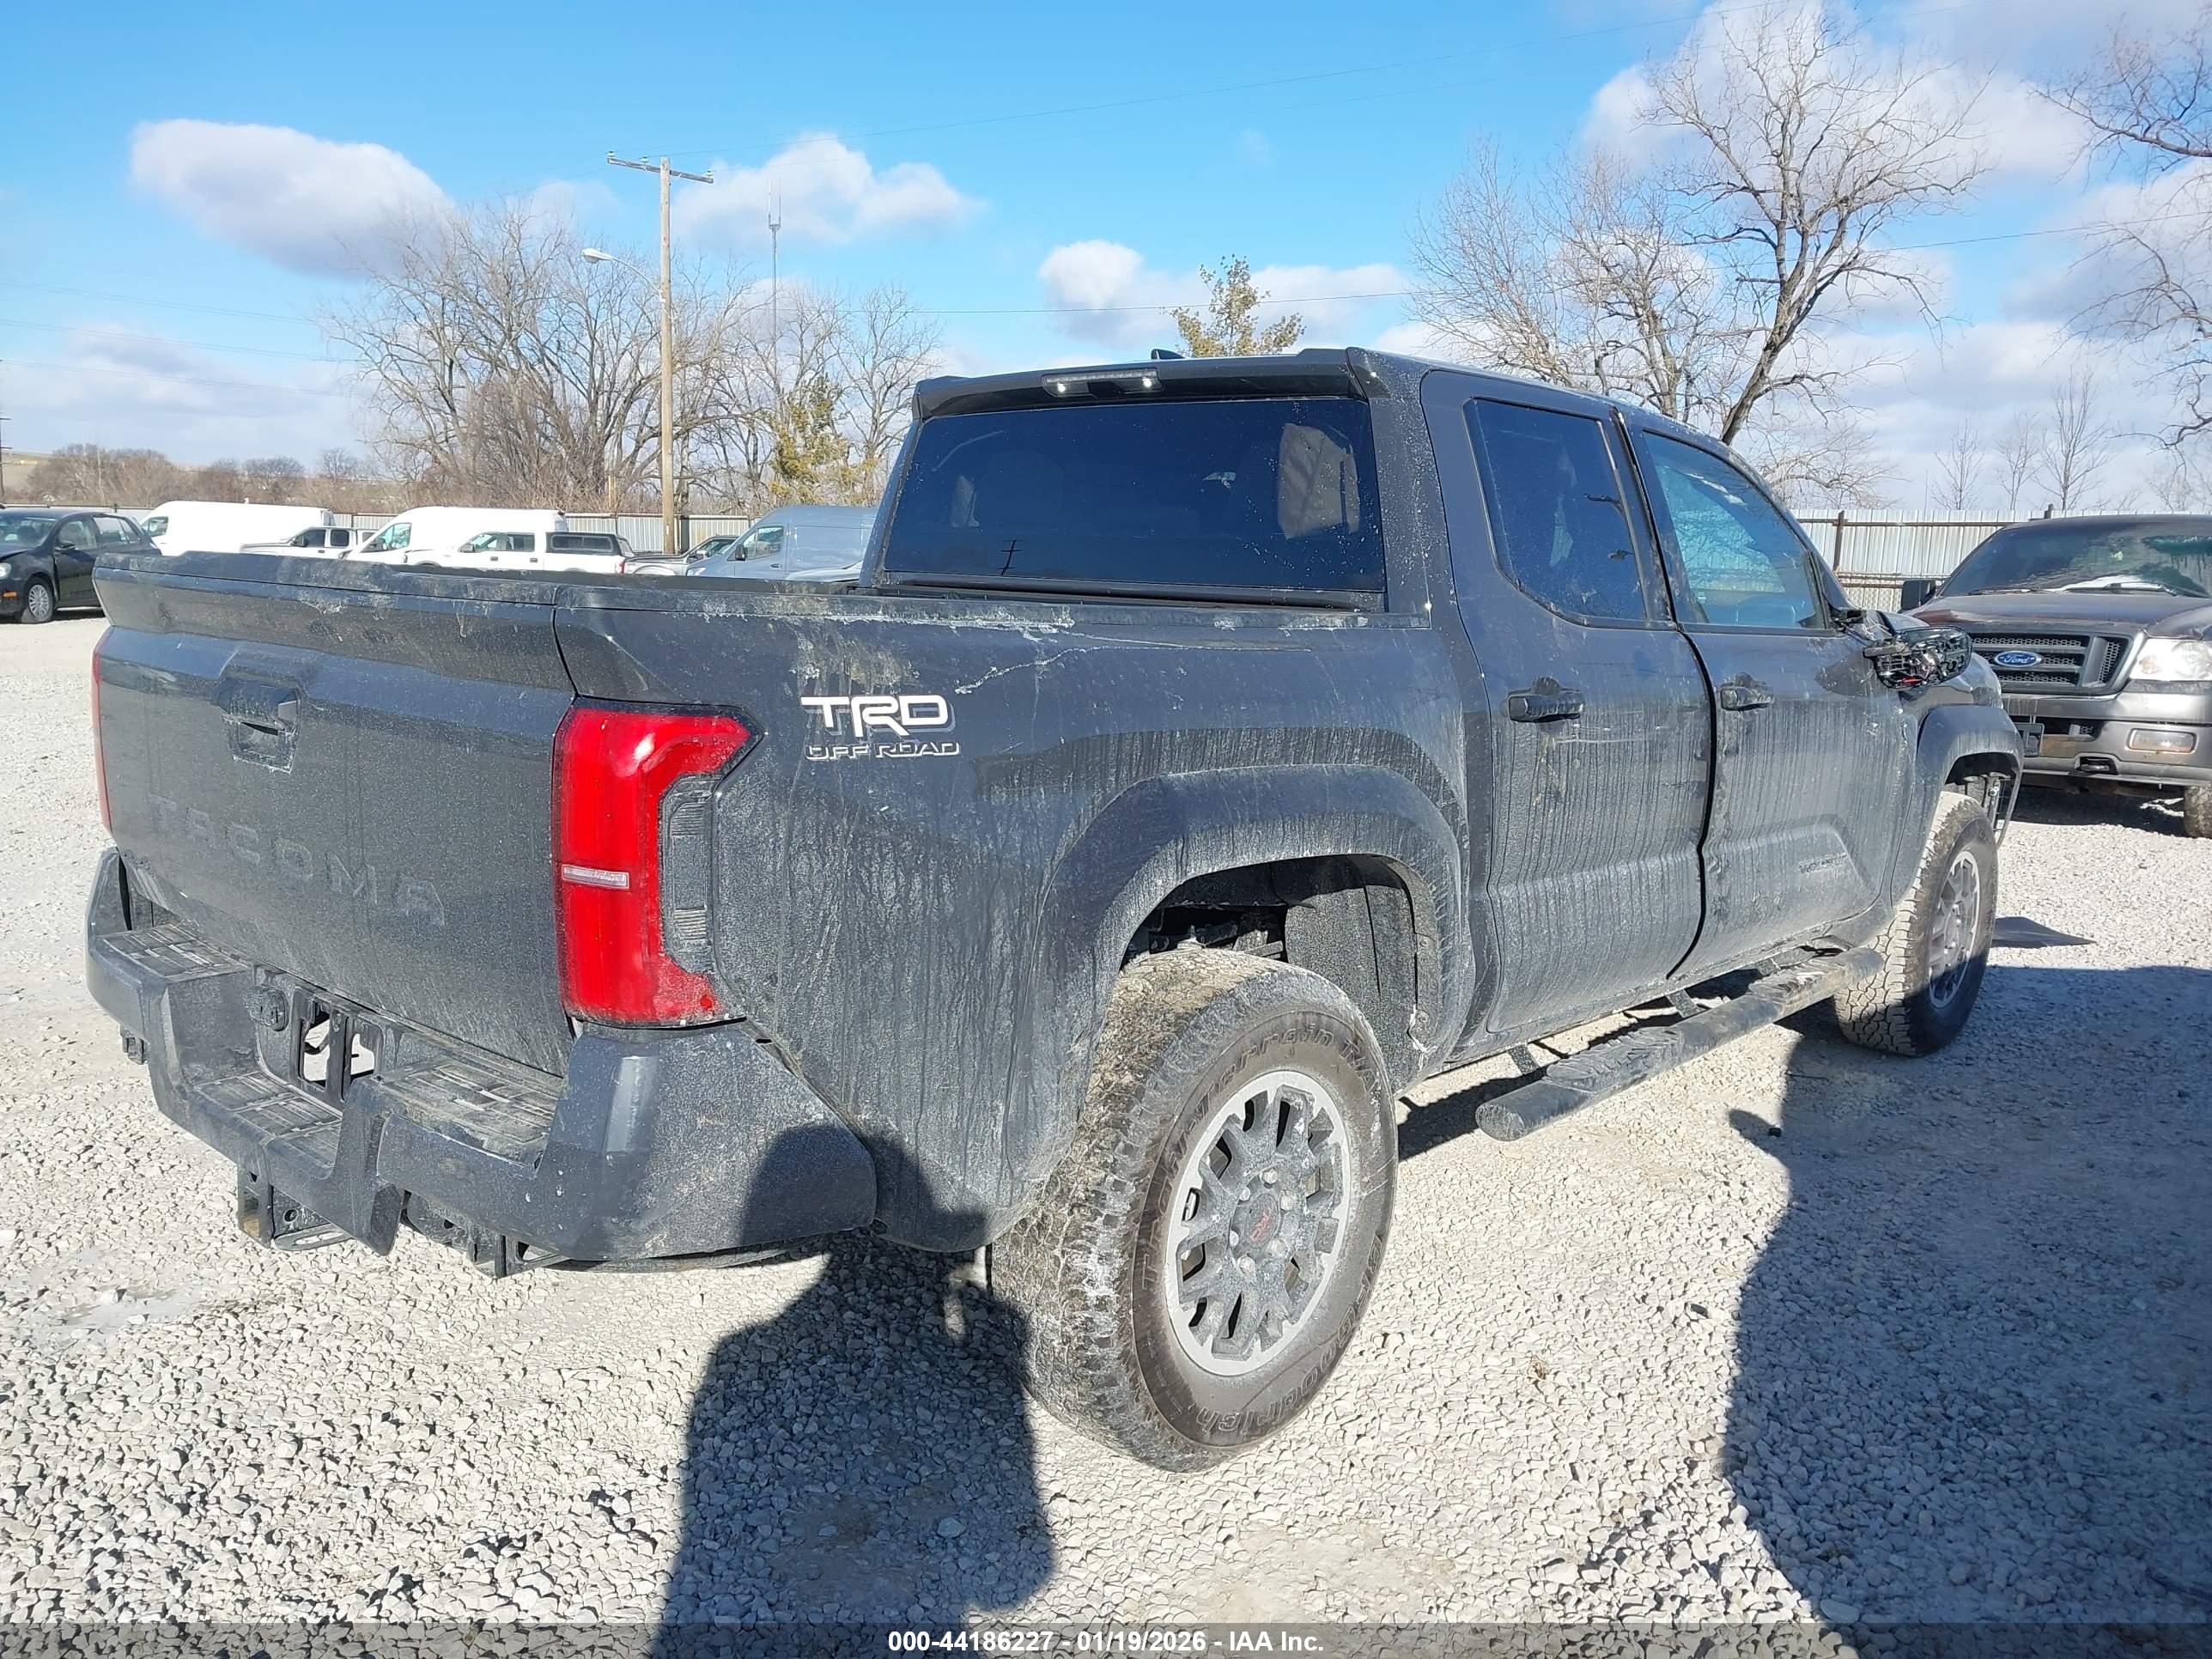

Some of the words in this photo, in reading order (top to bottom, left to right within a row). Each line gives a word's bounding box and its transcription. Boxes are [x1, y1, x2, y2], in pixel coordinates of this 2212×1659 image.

[2003, 653, 2030, 664] Ford
[800, 695, 953, 738] TRD
[805, 744, 871, 760] OFF
[874, 741, 961, 758] ROAD
[1195, 1234, 1382, 1437] BFGoodrich
